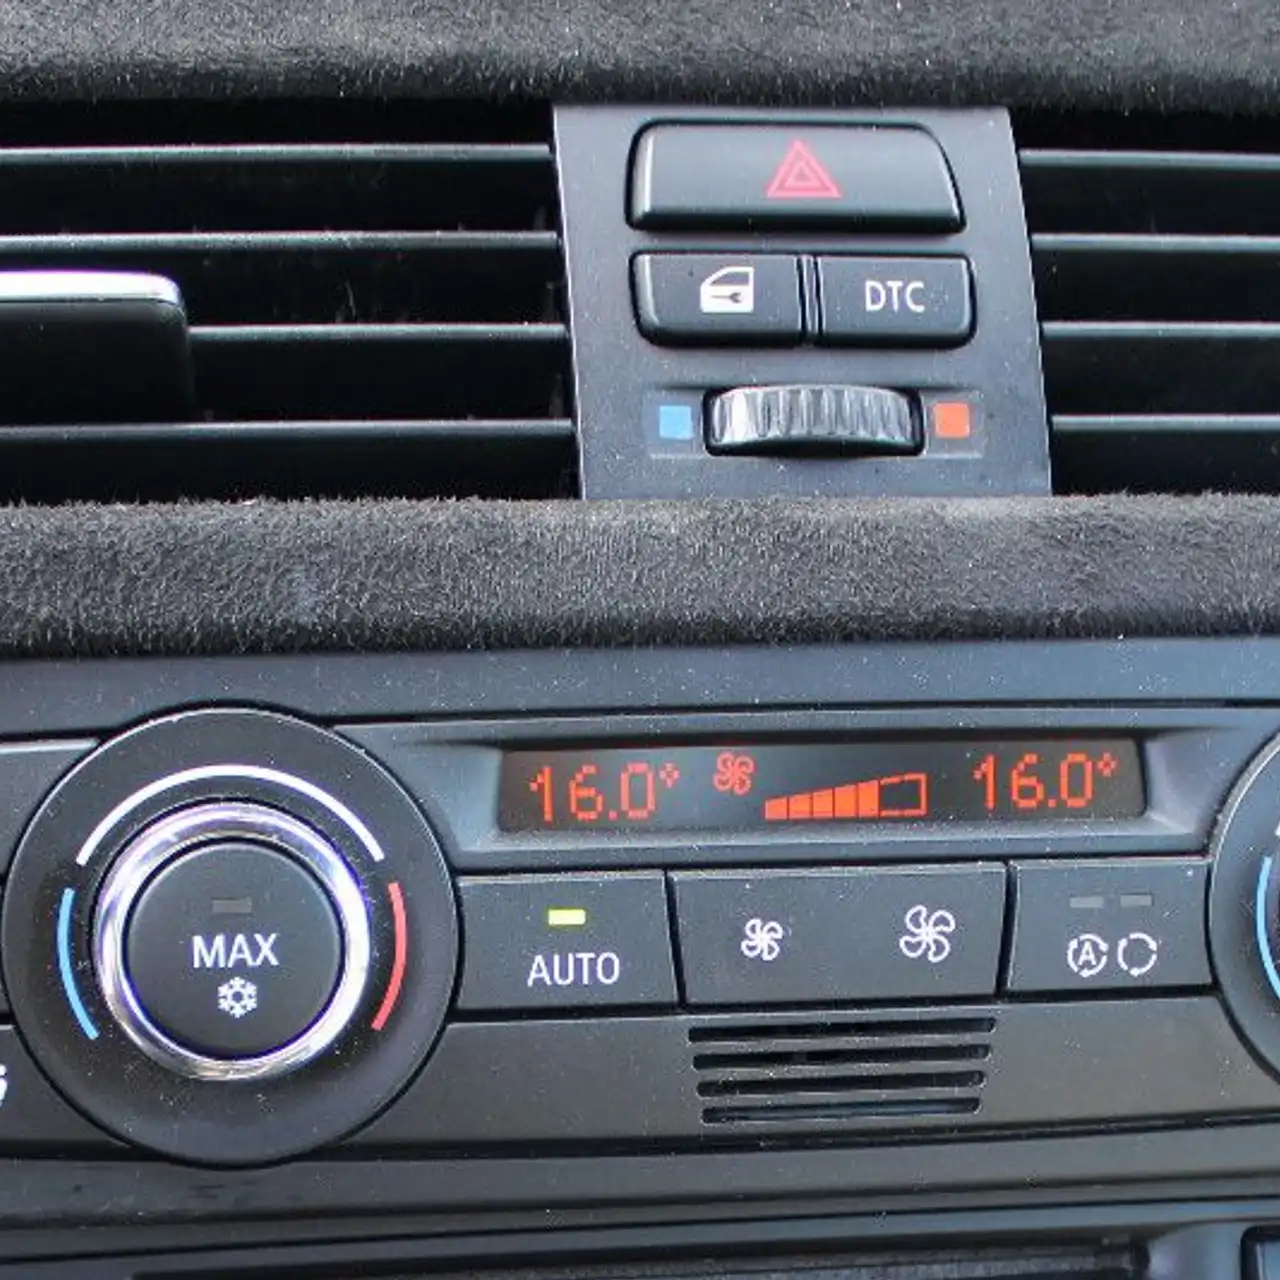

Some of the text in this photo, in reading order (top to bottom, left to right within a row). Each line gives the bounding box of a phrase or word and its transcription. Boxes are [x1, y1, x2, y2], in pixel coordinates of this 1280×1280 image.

[865, 280, 925, 312] DTC
[193, 933, 278, 968] MAX
[528, 952, 619, 986] AUTO
